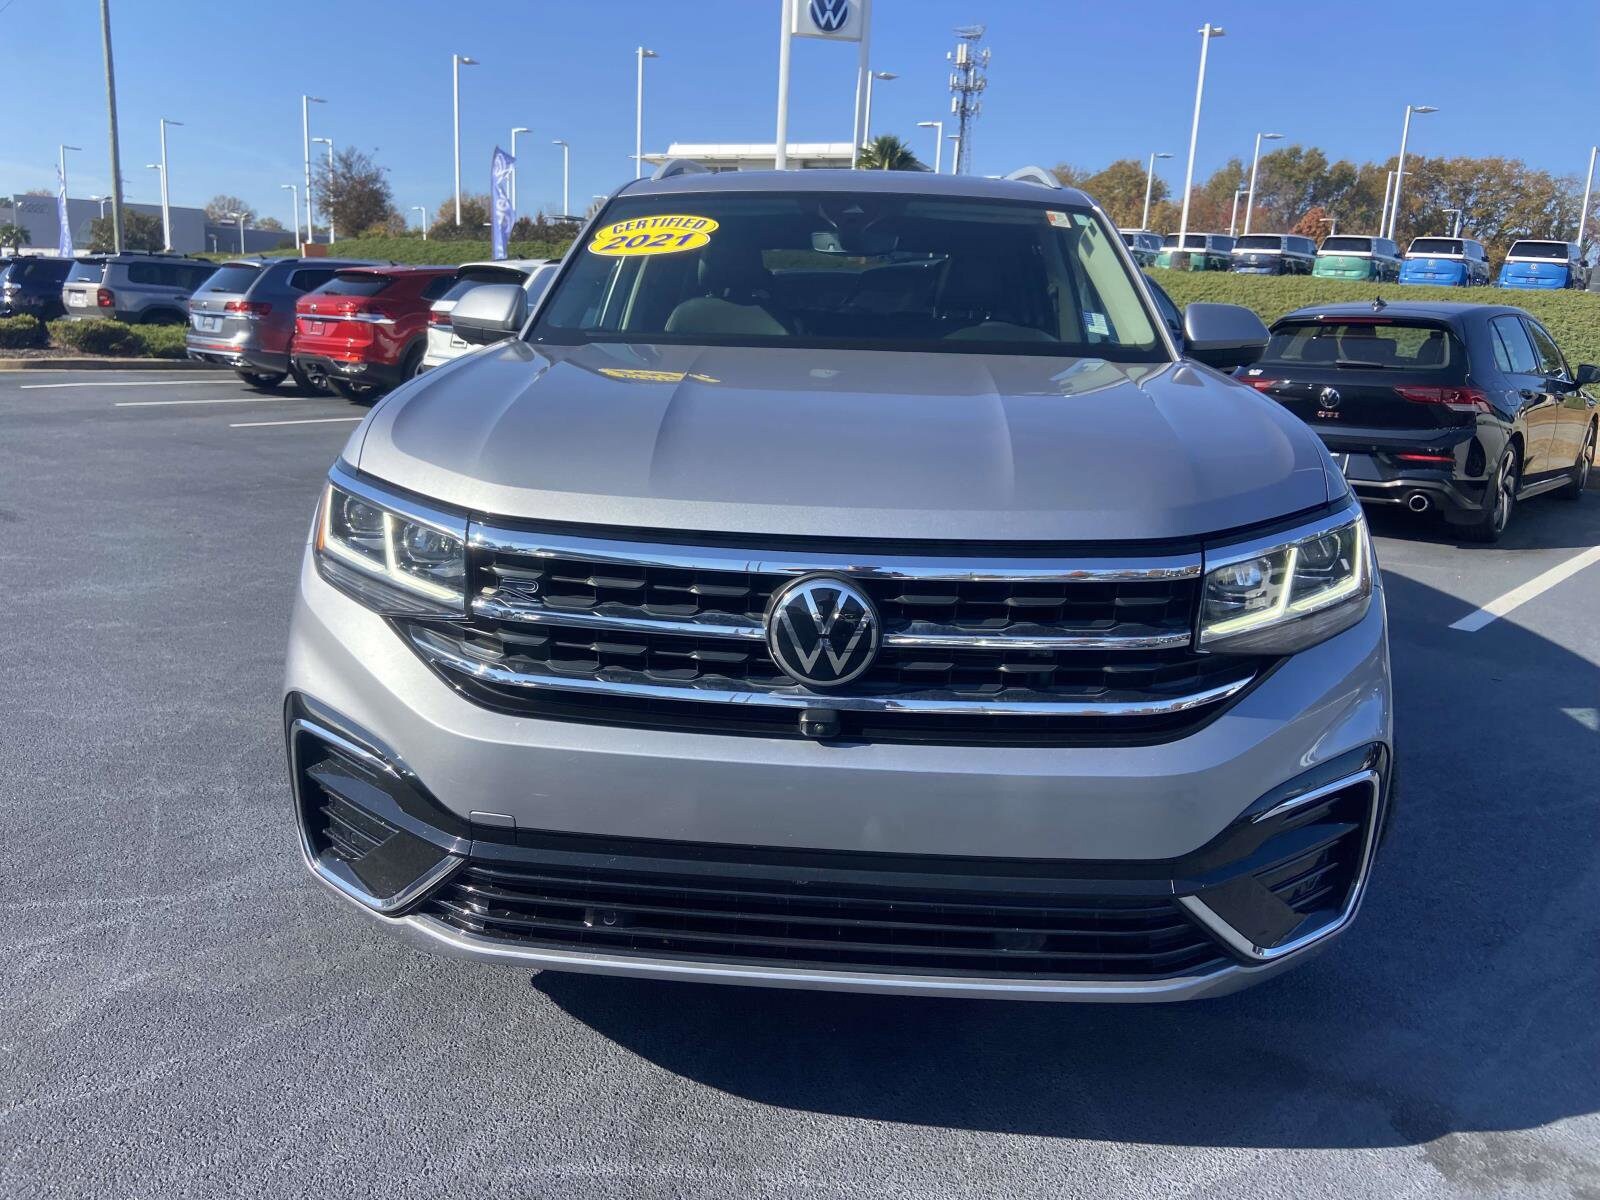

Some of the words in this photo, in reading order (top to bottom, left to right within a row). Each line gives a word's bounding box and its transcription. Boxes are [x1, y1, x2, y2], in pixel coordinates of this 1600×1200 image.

[613, 217, 707, 235] CERTIFIED
[601, 233, 695, 250] 2021
[1317, 410, 1340, 418] GTI
